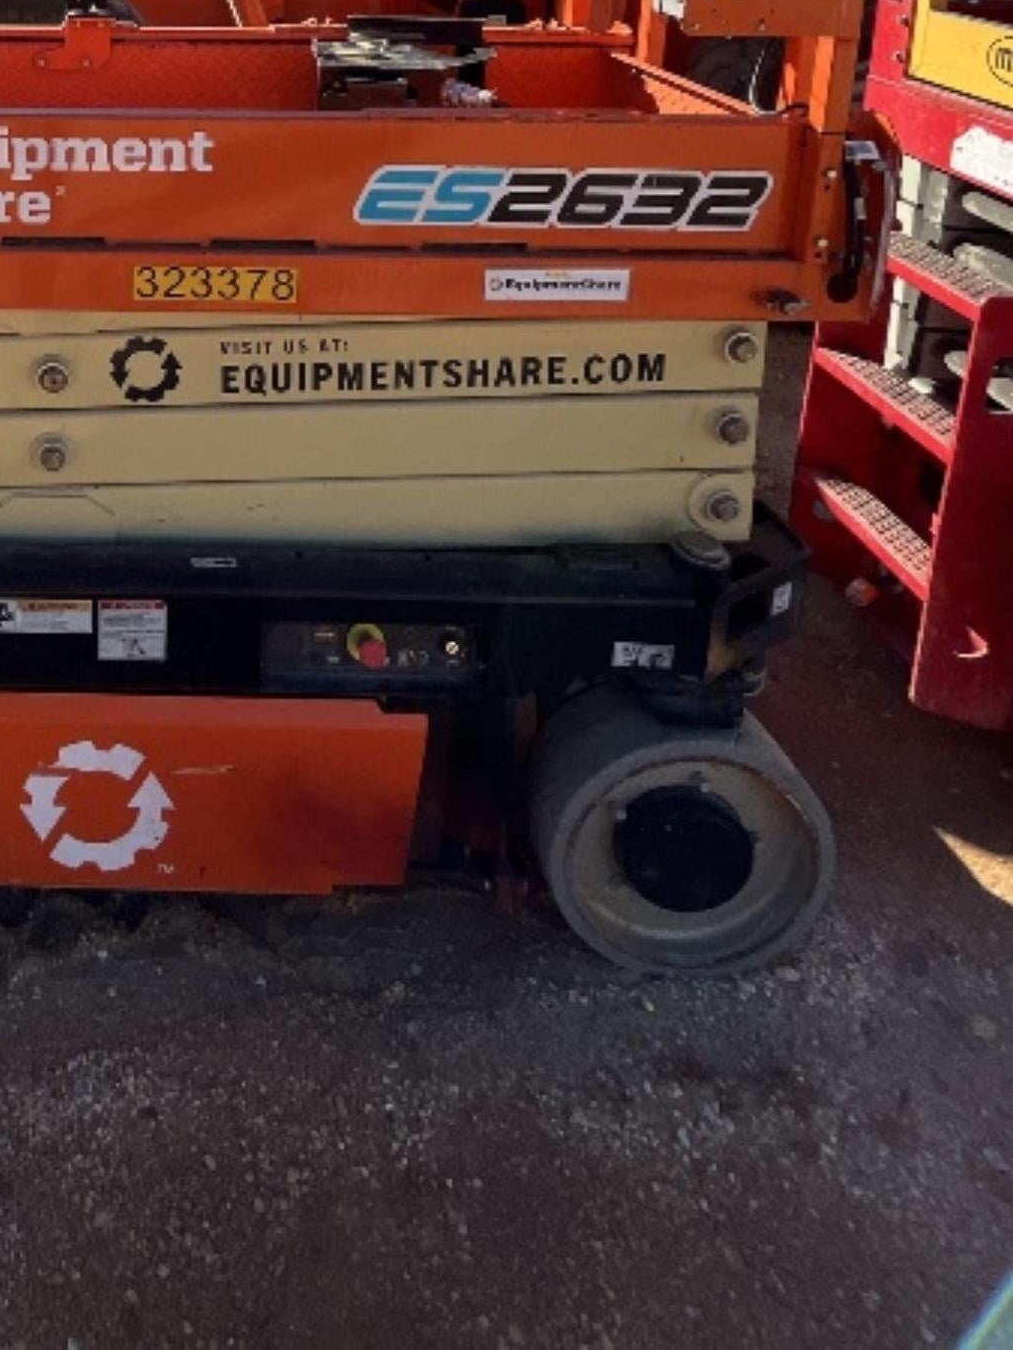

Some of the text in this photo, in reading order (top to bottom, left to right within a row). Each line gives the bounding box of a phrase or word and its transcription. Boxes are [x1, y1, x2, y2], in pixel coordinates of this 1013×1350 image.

[355, 165, 773, 231] ES2632
[135, 266, 294, 302] 323378
[220, 341, 273, 356] VISIT
[282, 339, 309, 354] US
[220, 353, 667, 397] EQUIPMENTSHARE.COM
